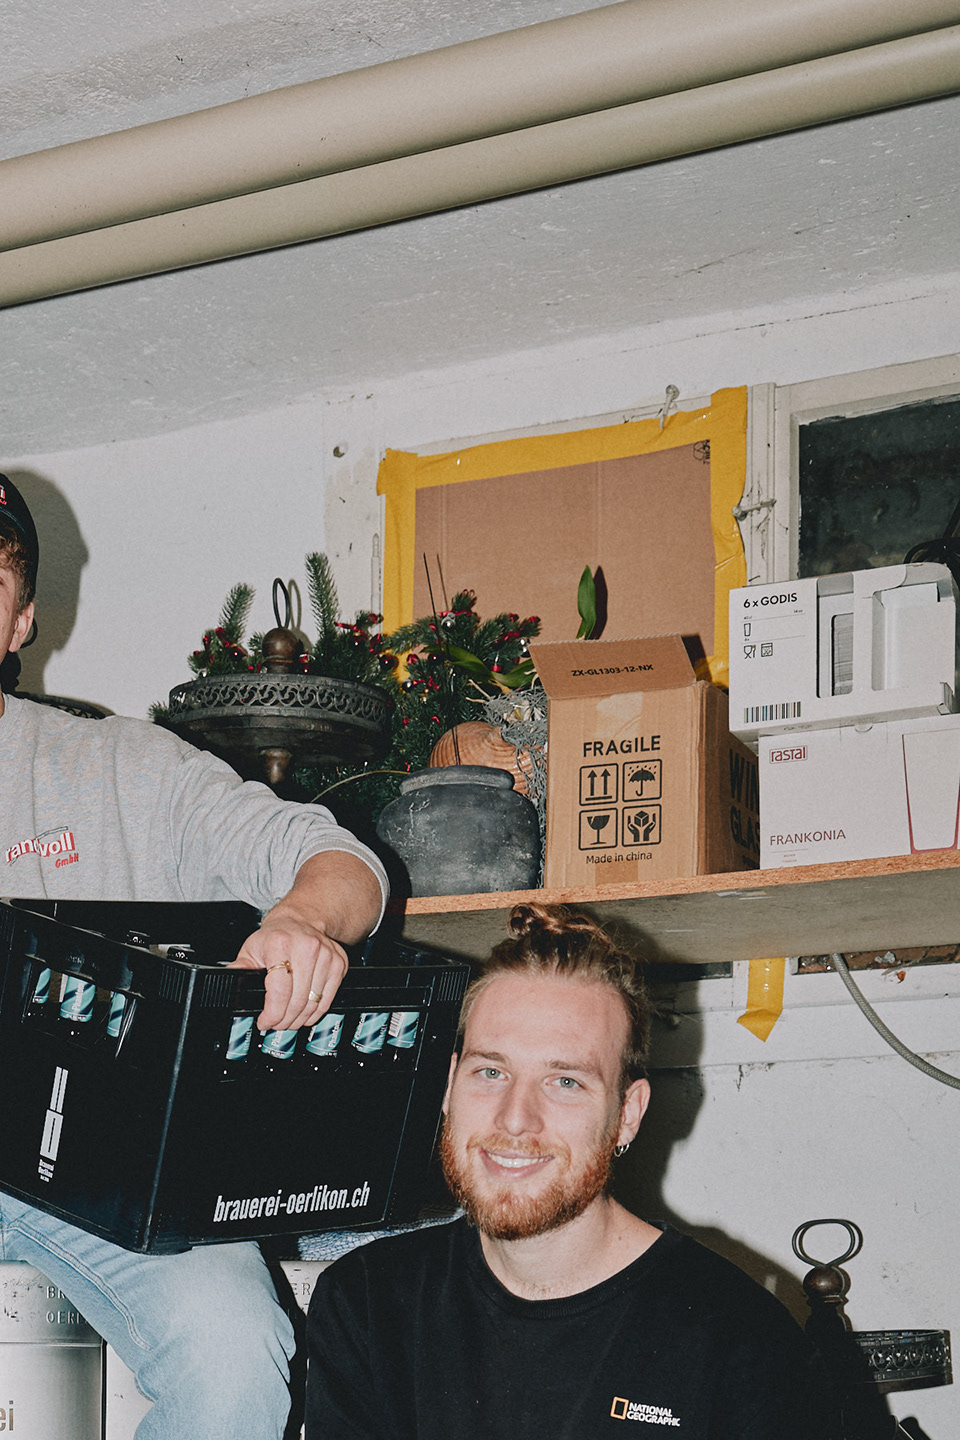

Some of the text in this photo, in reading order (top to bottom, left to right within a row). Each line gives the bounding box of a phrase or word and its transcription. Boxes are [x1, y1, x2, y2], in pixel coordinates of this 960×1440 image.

[743, 599, 751, 608] 6
[760, 593, 797, 606] GODIS
[571, 664, 654, 677] ZX-GL1303-12-NX
[583, 735, 661, 757] FRAGILE
[771, 746, 806, 762] rastal
[770, 829, 846, 846] FRANKONIA
[6, 832, 75, 862] randvoll
[586, 851, 653, 864] Made in china
[213, 1181, 371, 1223] brauerei-oerlikon.ch
[629, 1402, 673, 1417] NATIONAL
[627, 1410, 681, 1427] GEOGRAPHIC
